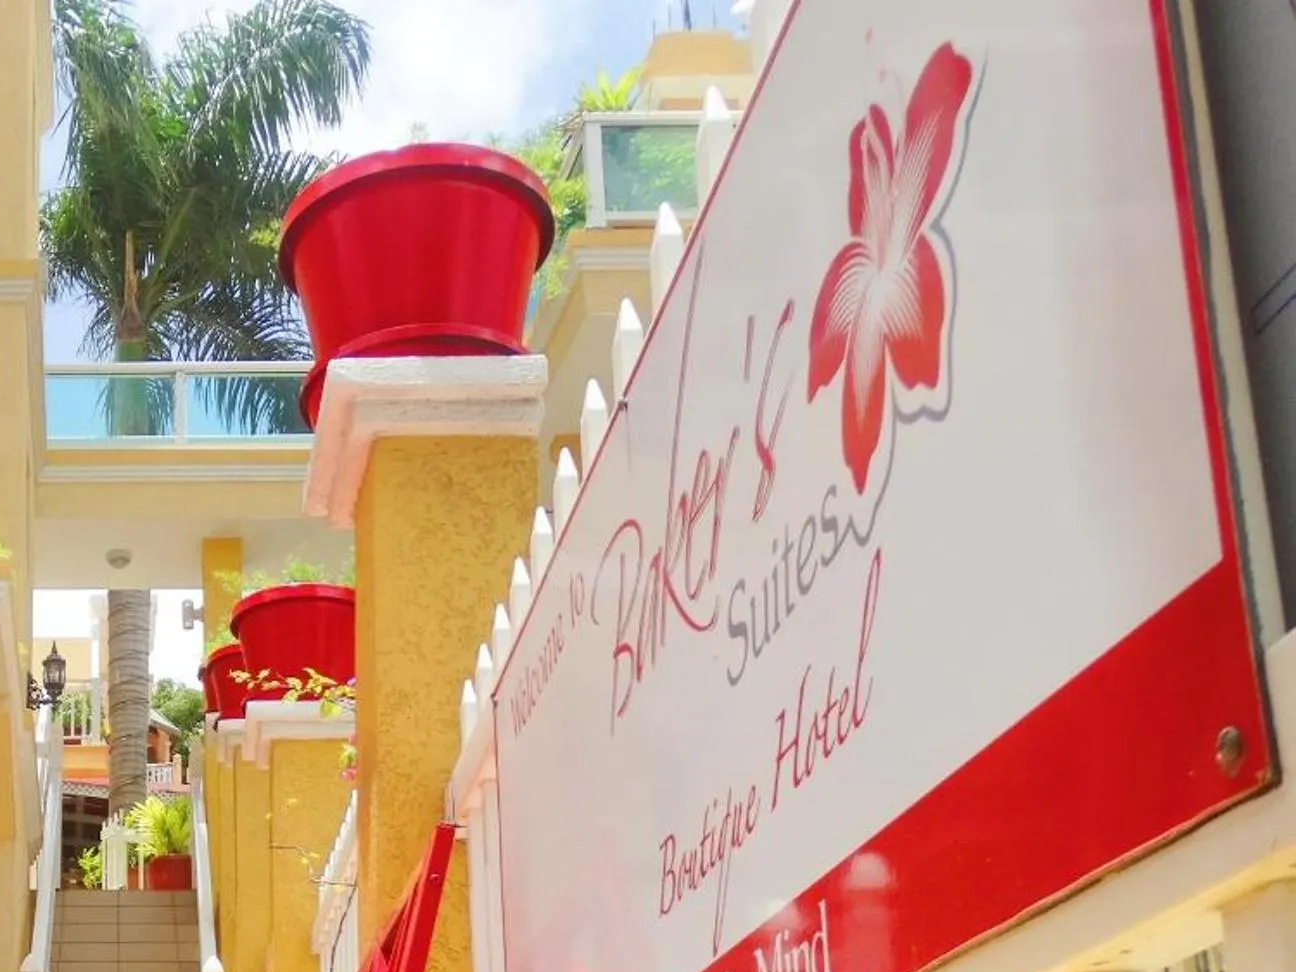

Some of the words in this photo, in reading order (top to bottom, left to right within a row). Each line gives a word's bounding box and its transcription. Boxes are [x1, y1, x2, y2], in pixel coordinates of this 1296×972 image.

[590, 232, 800, 737] Baker's
[726, 483, 851, 687] Suites
[509, 612, 566, 741] Welcome
[569, 569, 586, 628] to
[659, 783, 762, 958] Boutique
[769, 546, 883, 812] Hotel
